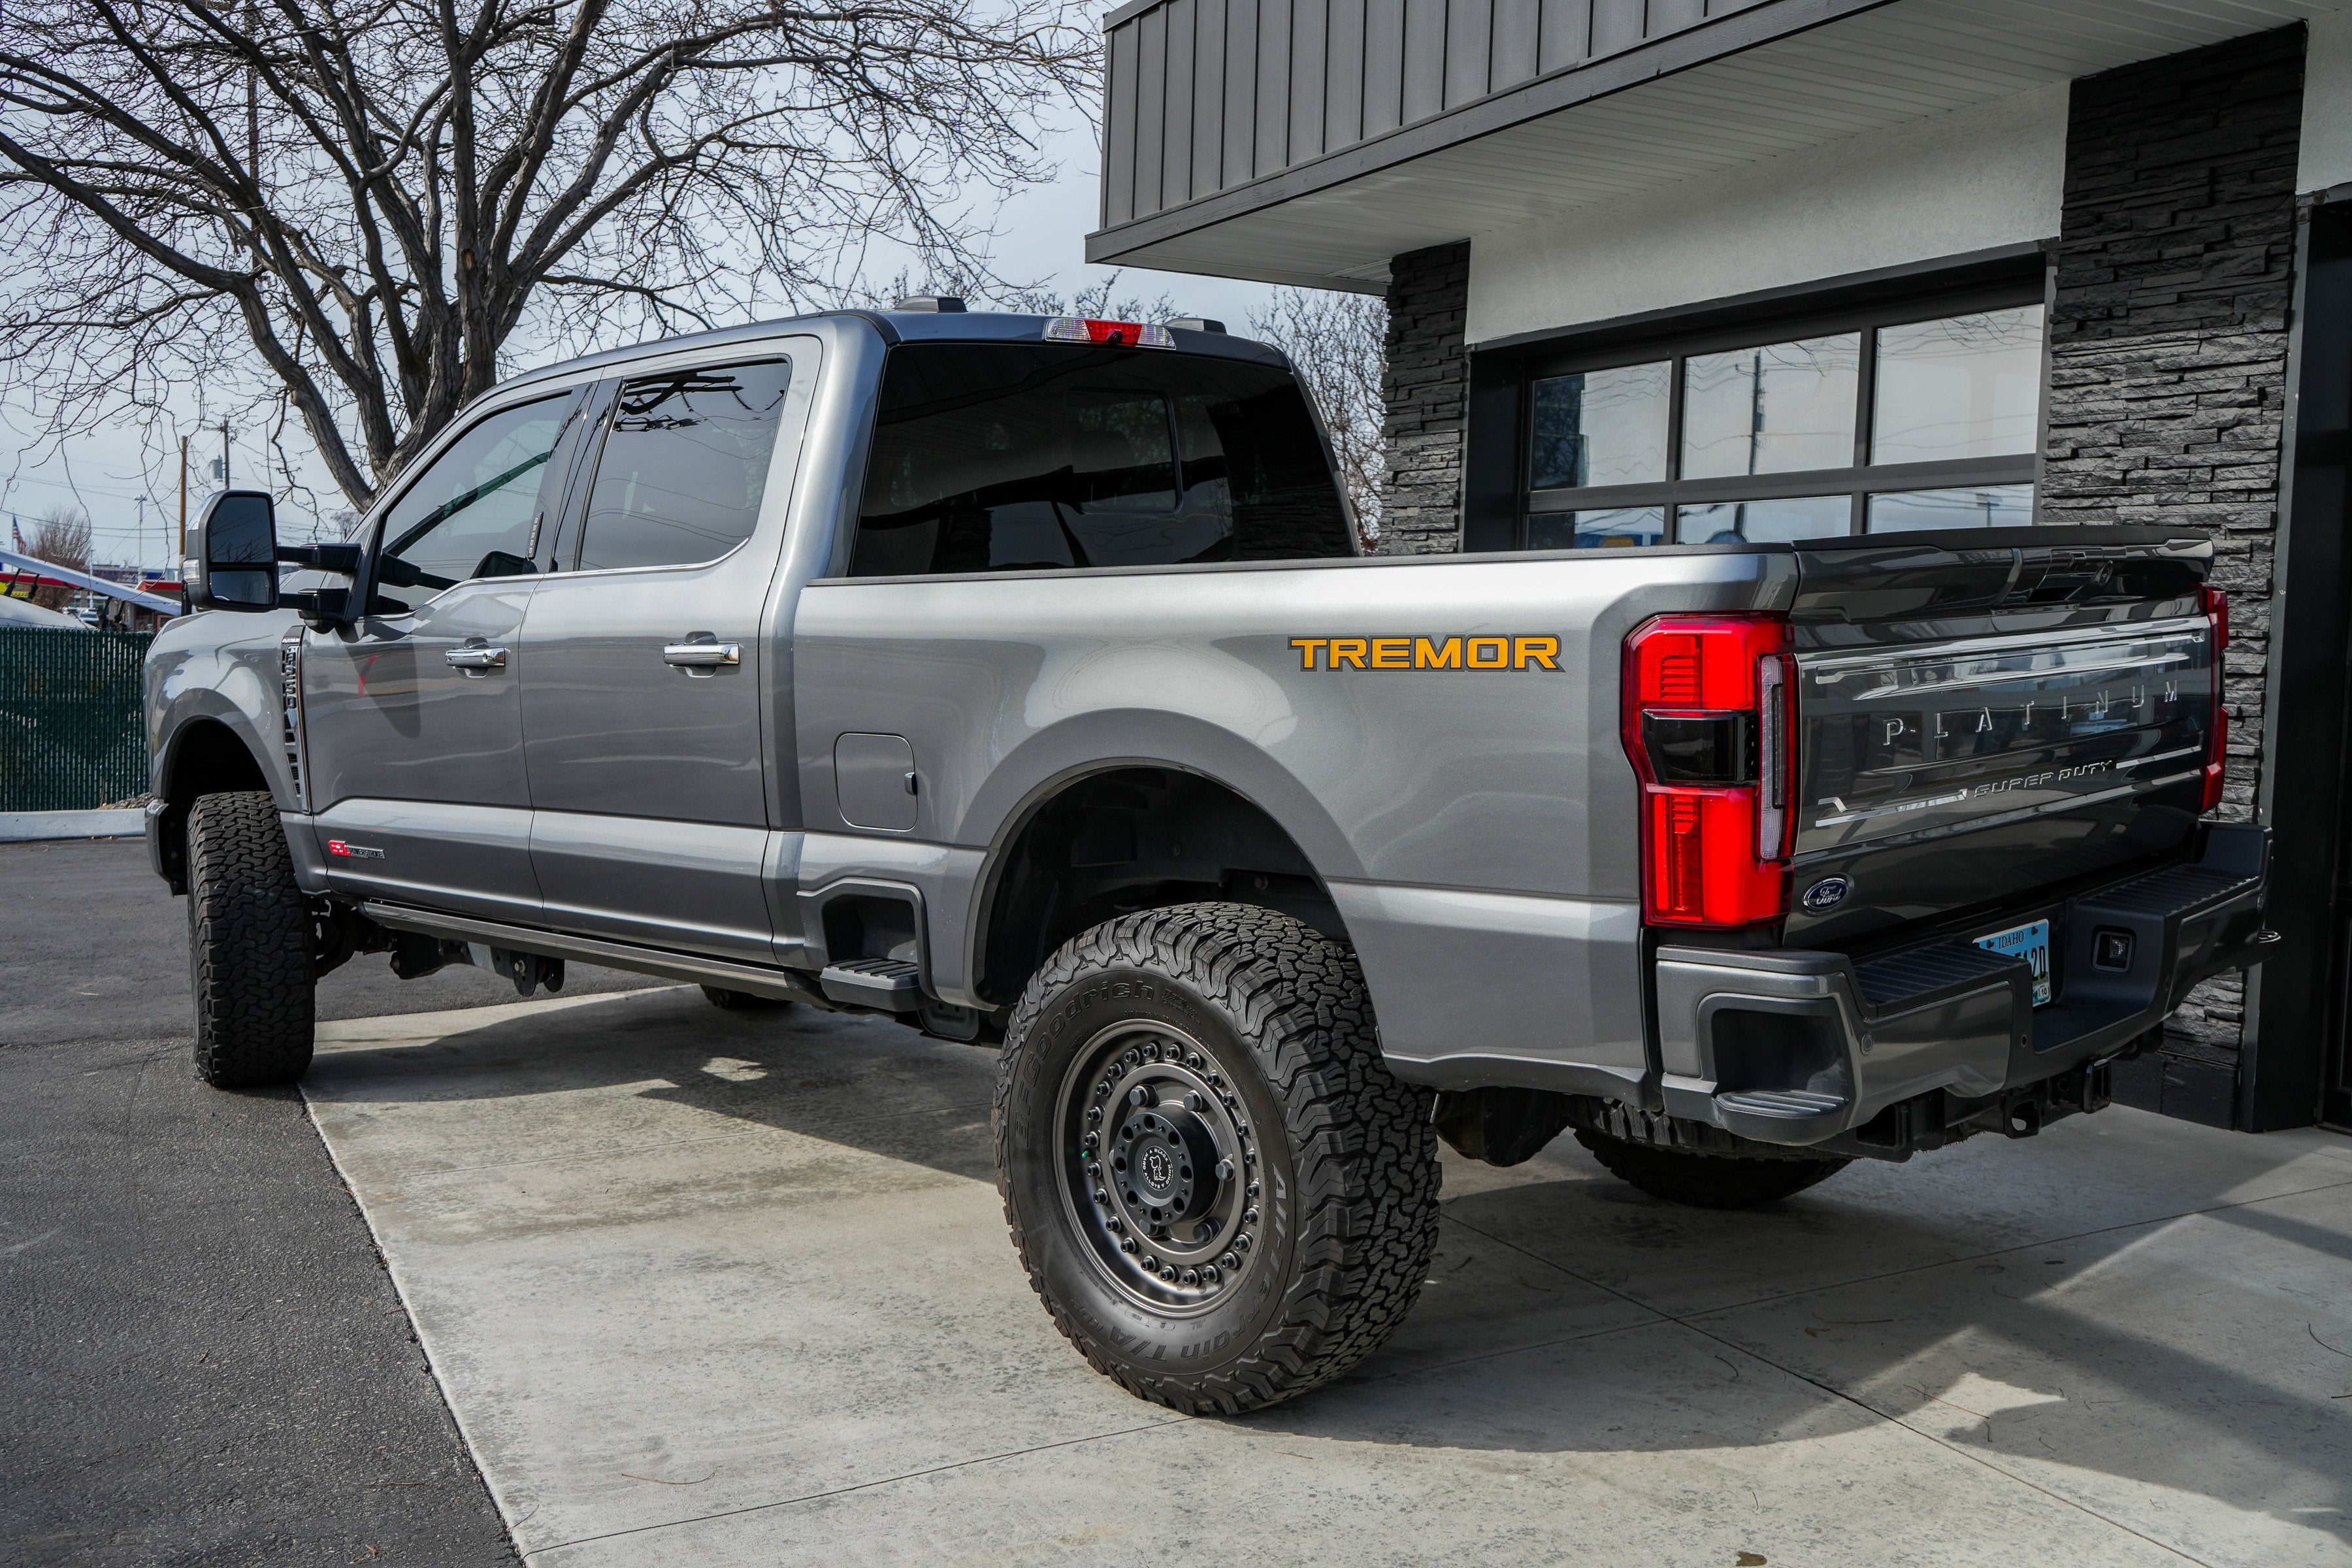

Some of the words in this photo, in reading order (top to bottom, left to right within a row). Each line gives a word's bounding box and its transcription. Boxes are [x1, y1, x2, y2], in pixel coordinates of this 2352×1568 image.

[1288, 634, 1565, 672] TREMOR
[1883, 679, 2178, 746] PLATINUM
[1974, 772, 2055, 798] SUPER
[2058, 760, 2112, 781] DUTY
[1816, 885, 1842, 905] Ford
[1998, 930, 2024, 949] IDAHO
[2015, 945, 2046, 981] 2D
[2041, 987, 2048, 996] 10
[1015, 980, 1155, 1149] BFGoodrich
[1154, 1148, 1168, 1162] BLACK
[1144, 1172, 1160, 1188] ALLOYS
[1109, 1326, 1167, 1364] T/A
